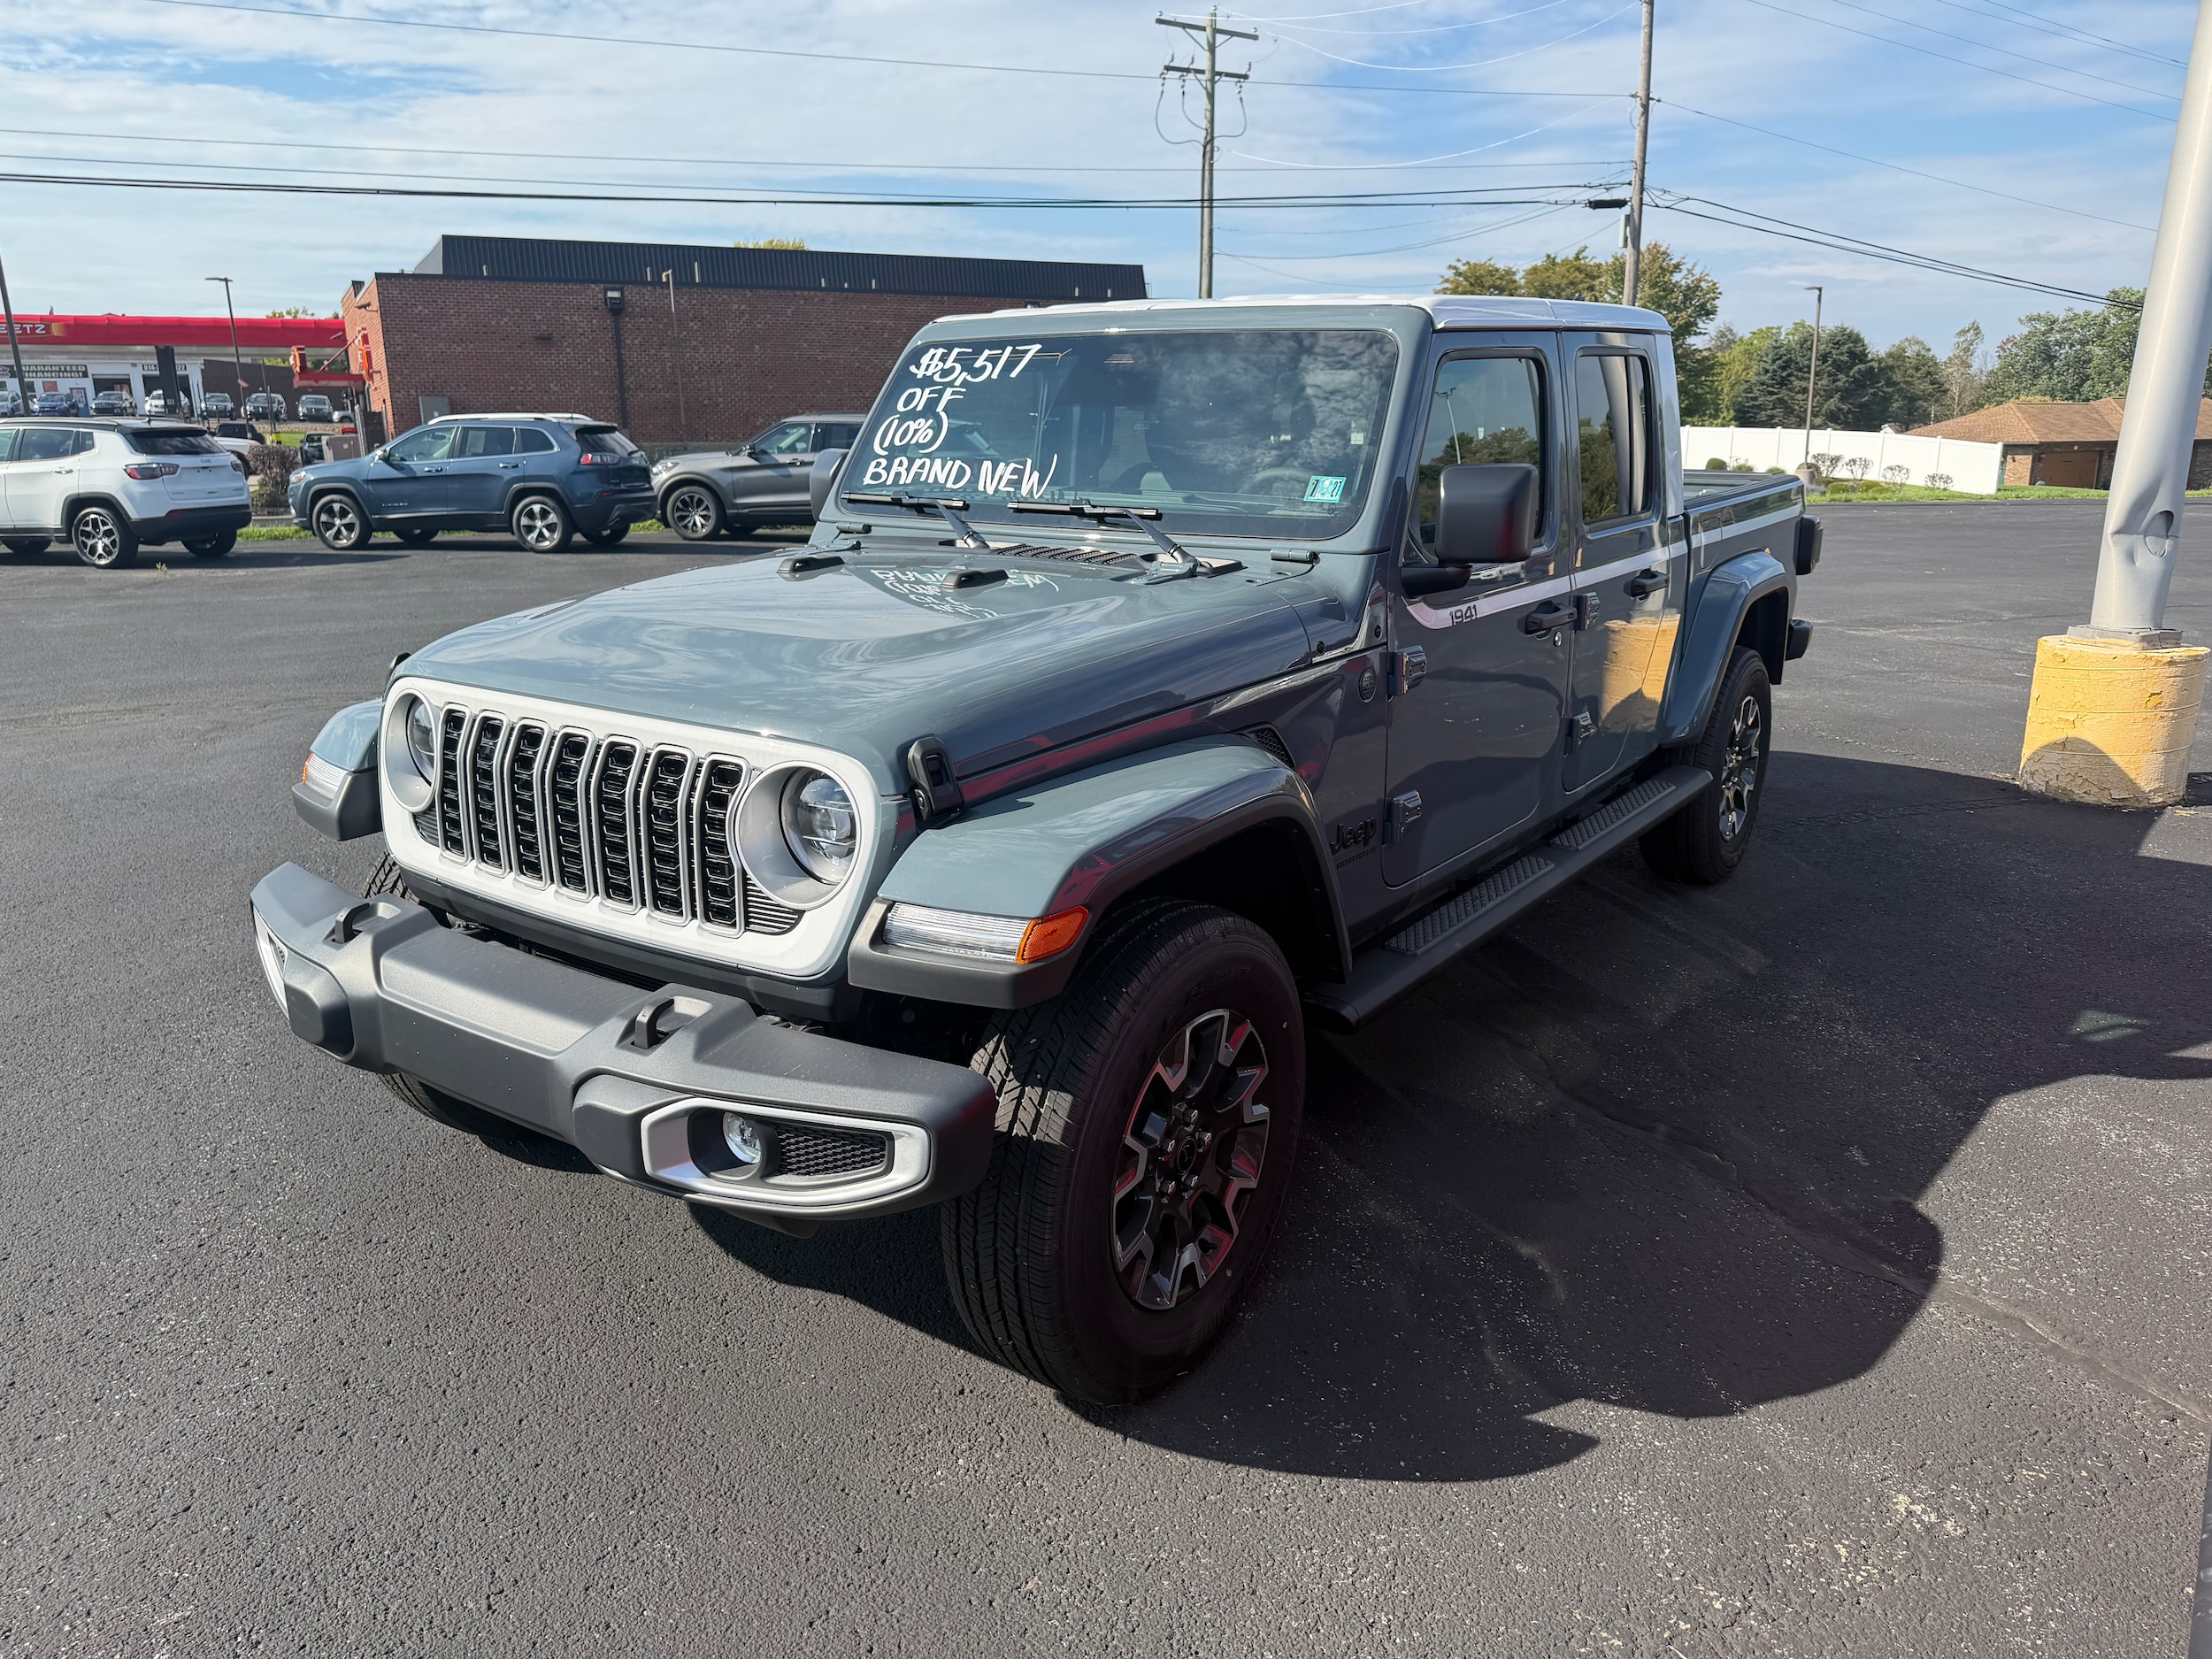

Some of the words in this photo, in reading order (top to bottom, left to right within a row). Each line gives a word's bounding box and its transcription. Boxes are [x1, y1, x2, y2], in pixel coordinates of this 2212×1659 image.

[910, 343, 1042, 387] $5,517
[896, 385, 966, 412] OFF
[873, 411, 949, 456] (10%)
[863, 456, 972, 489] BRAND
[978, 453, 1057, 499] NEW
[1449, 604, 1478, 626] 1941
[1329, 817, 1377, 855] Jeep
